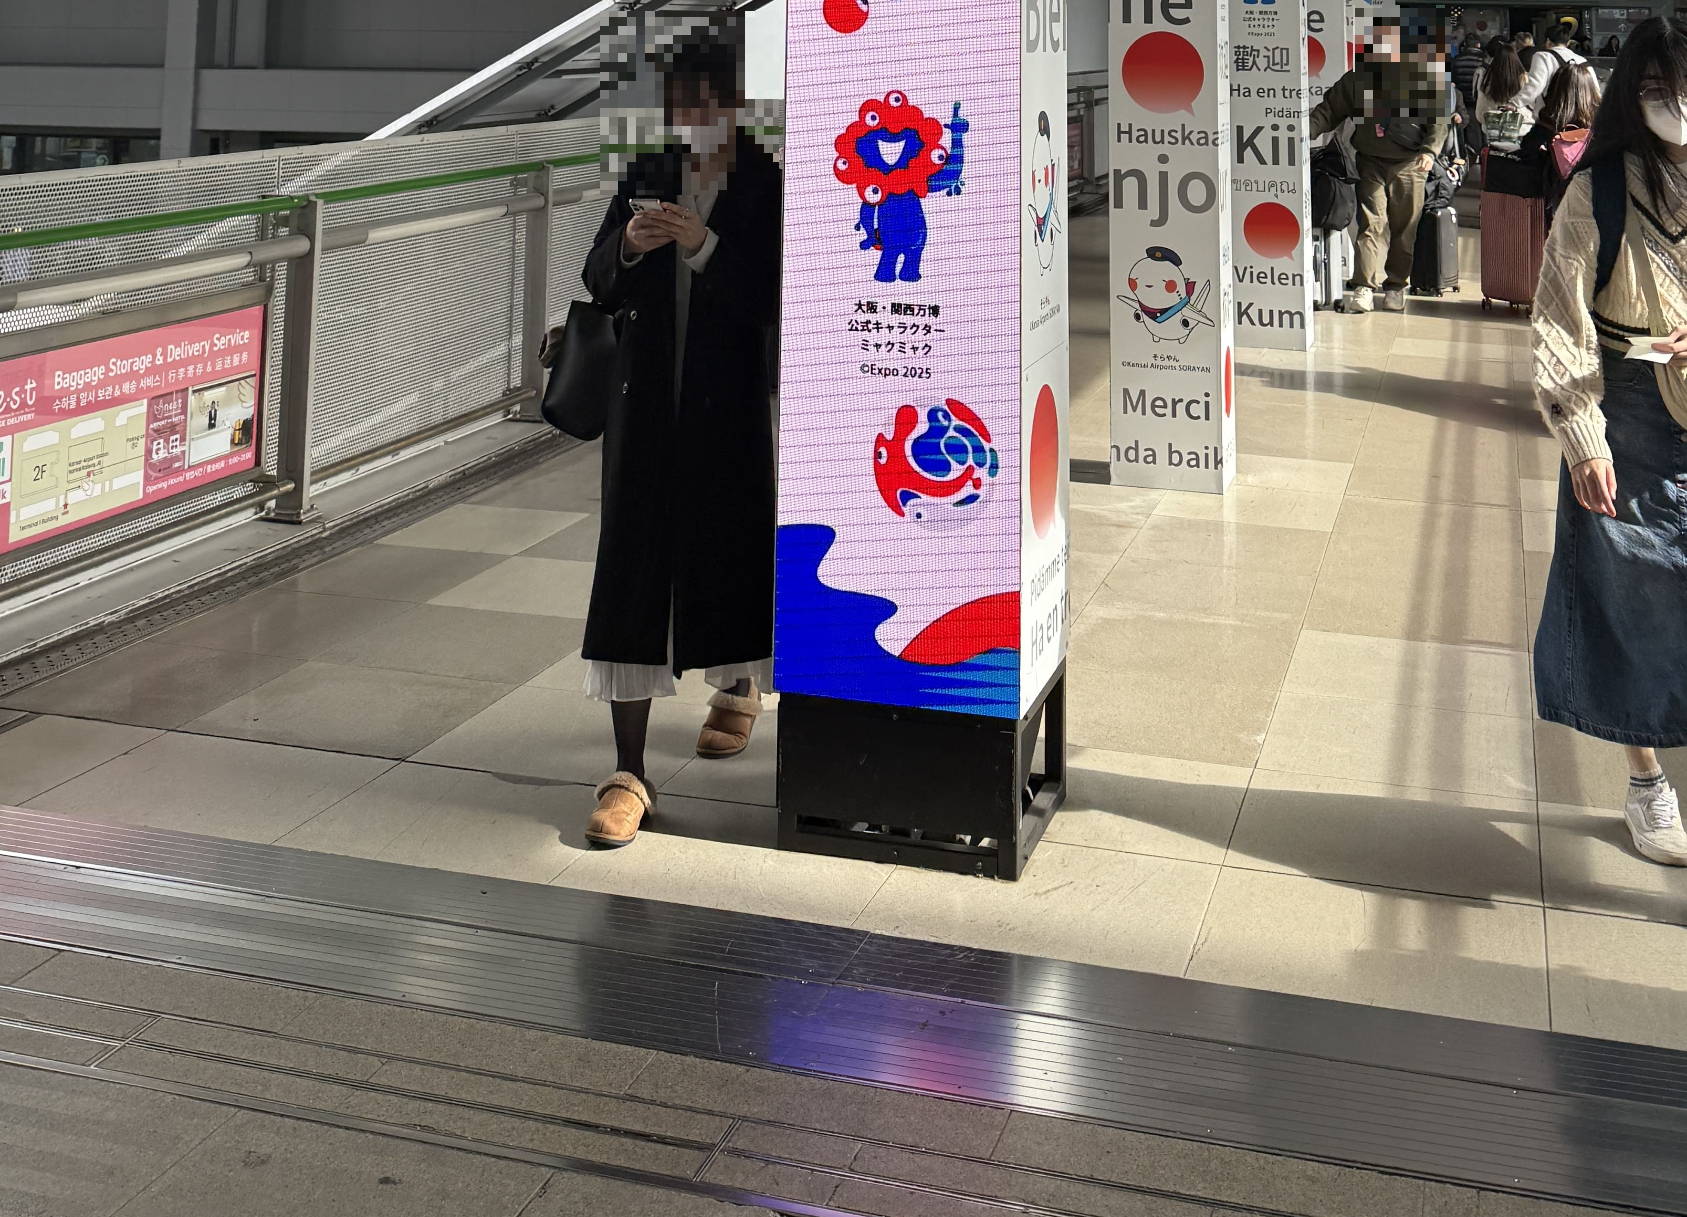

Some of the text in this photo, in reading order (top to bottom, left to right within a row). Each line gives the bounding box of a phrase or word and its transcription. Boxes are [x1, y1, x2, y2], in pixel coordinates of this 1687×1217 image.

[1233, 45, 1291, 73] 歡迎
[1230, 83, 1252, 98] Ha
[1256, 86, 1277, 99] en
[1115, 121, 1220, 148] Hauskaa
[1235, 123, 1297, 167] Kii
[1112, 153, 1217, 228] njo
[1232, 264, 1304, 288] Vielen
[854, 300, 941, 319] 大阪・関西万博
[847, 319, 946, 335] 公式キャラクター
[54, 328, 250, 391] Baggage Storage & Delivery Service
[860, 339, 932, 356] ミャクミャク
[902, 365, 932, 380] 2025
[1150, 362, 1178, 372] Airports
[1178, 365, 1211, 374] SORAYAN
[52, 393, 77, 414] 수하물
[79, 390, 96, 408] 일시
[97, 385, 113, 401] 보관
[139, 372, 161, 391] 서비스
[1121, 387, 1211, 423] Merci
[1167, 442, 1224, 471] baik
[32, 463, 48, 482] 2F
